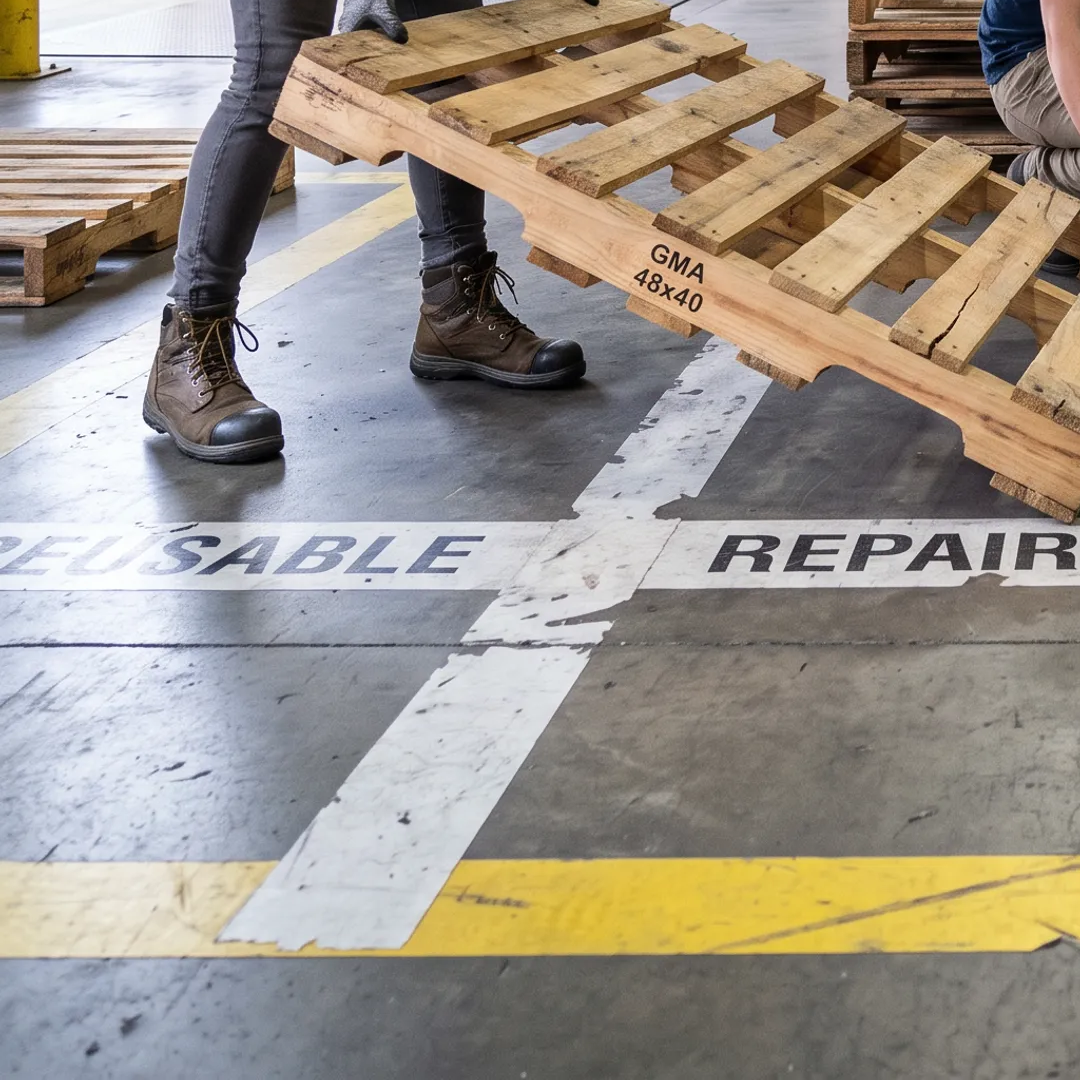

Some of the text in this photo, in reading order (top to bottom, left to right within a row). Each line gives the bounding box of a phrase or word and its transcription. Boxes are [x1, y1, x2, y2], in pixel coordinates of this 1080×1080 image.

[650, 243, 705, 285] GMA
[633, 268, 704, 313] 48x40
[0, 535, 487, 576] EUSABLE
